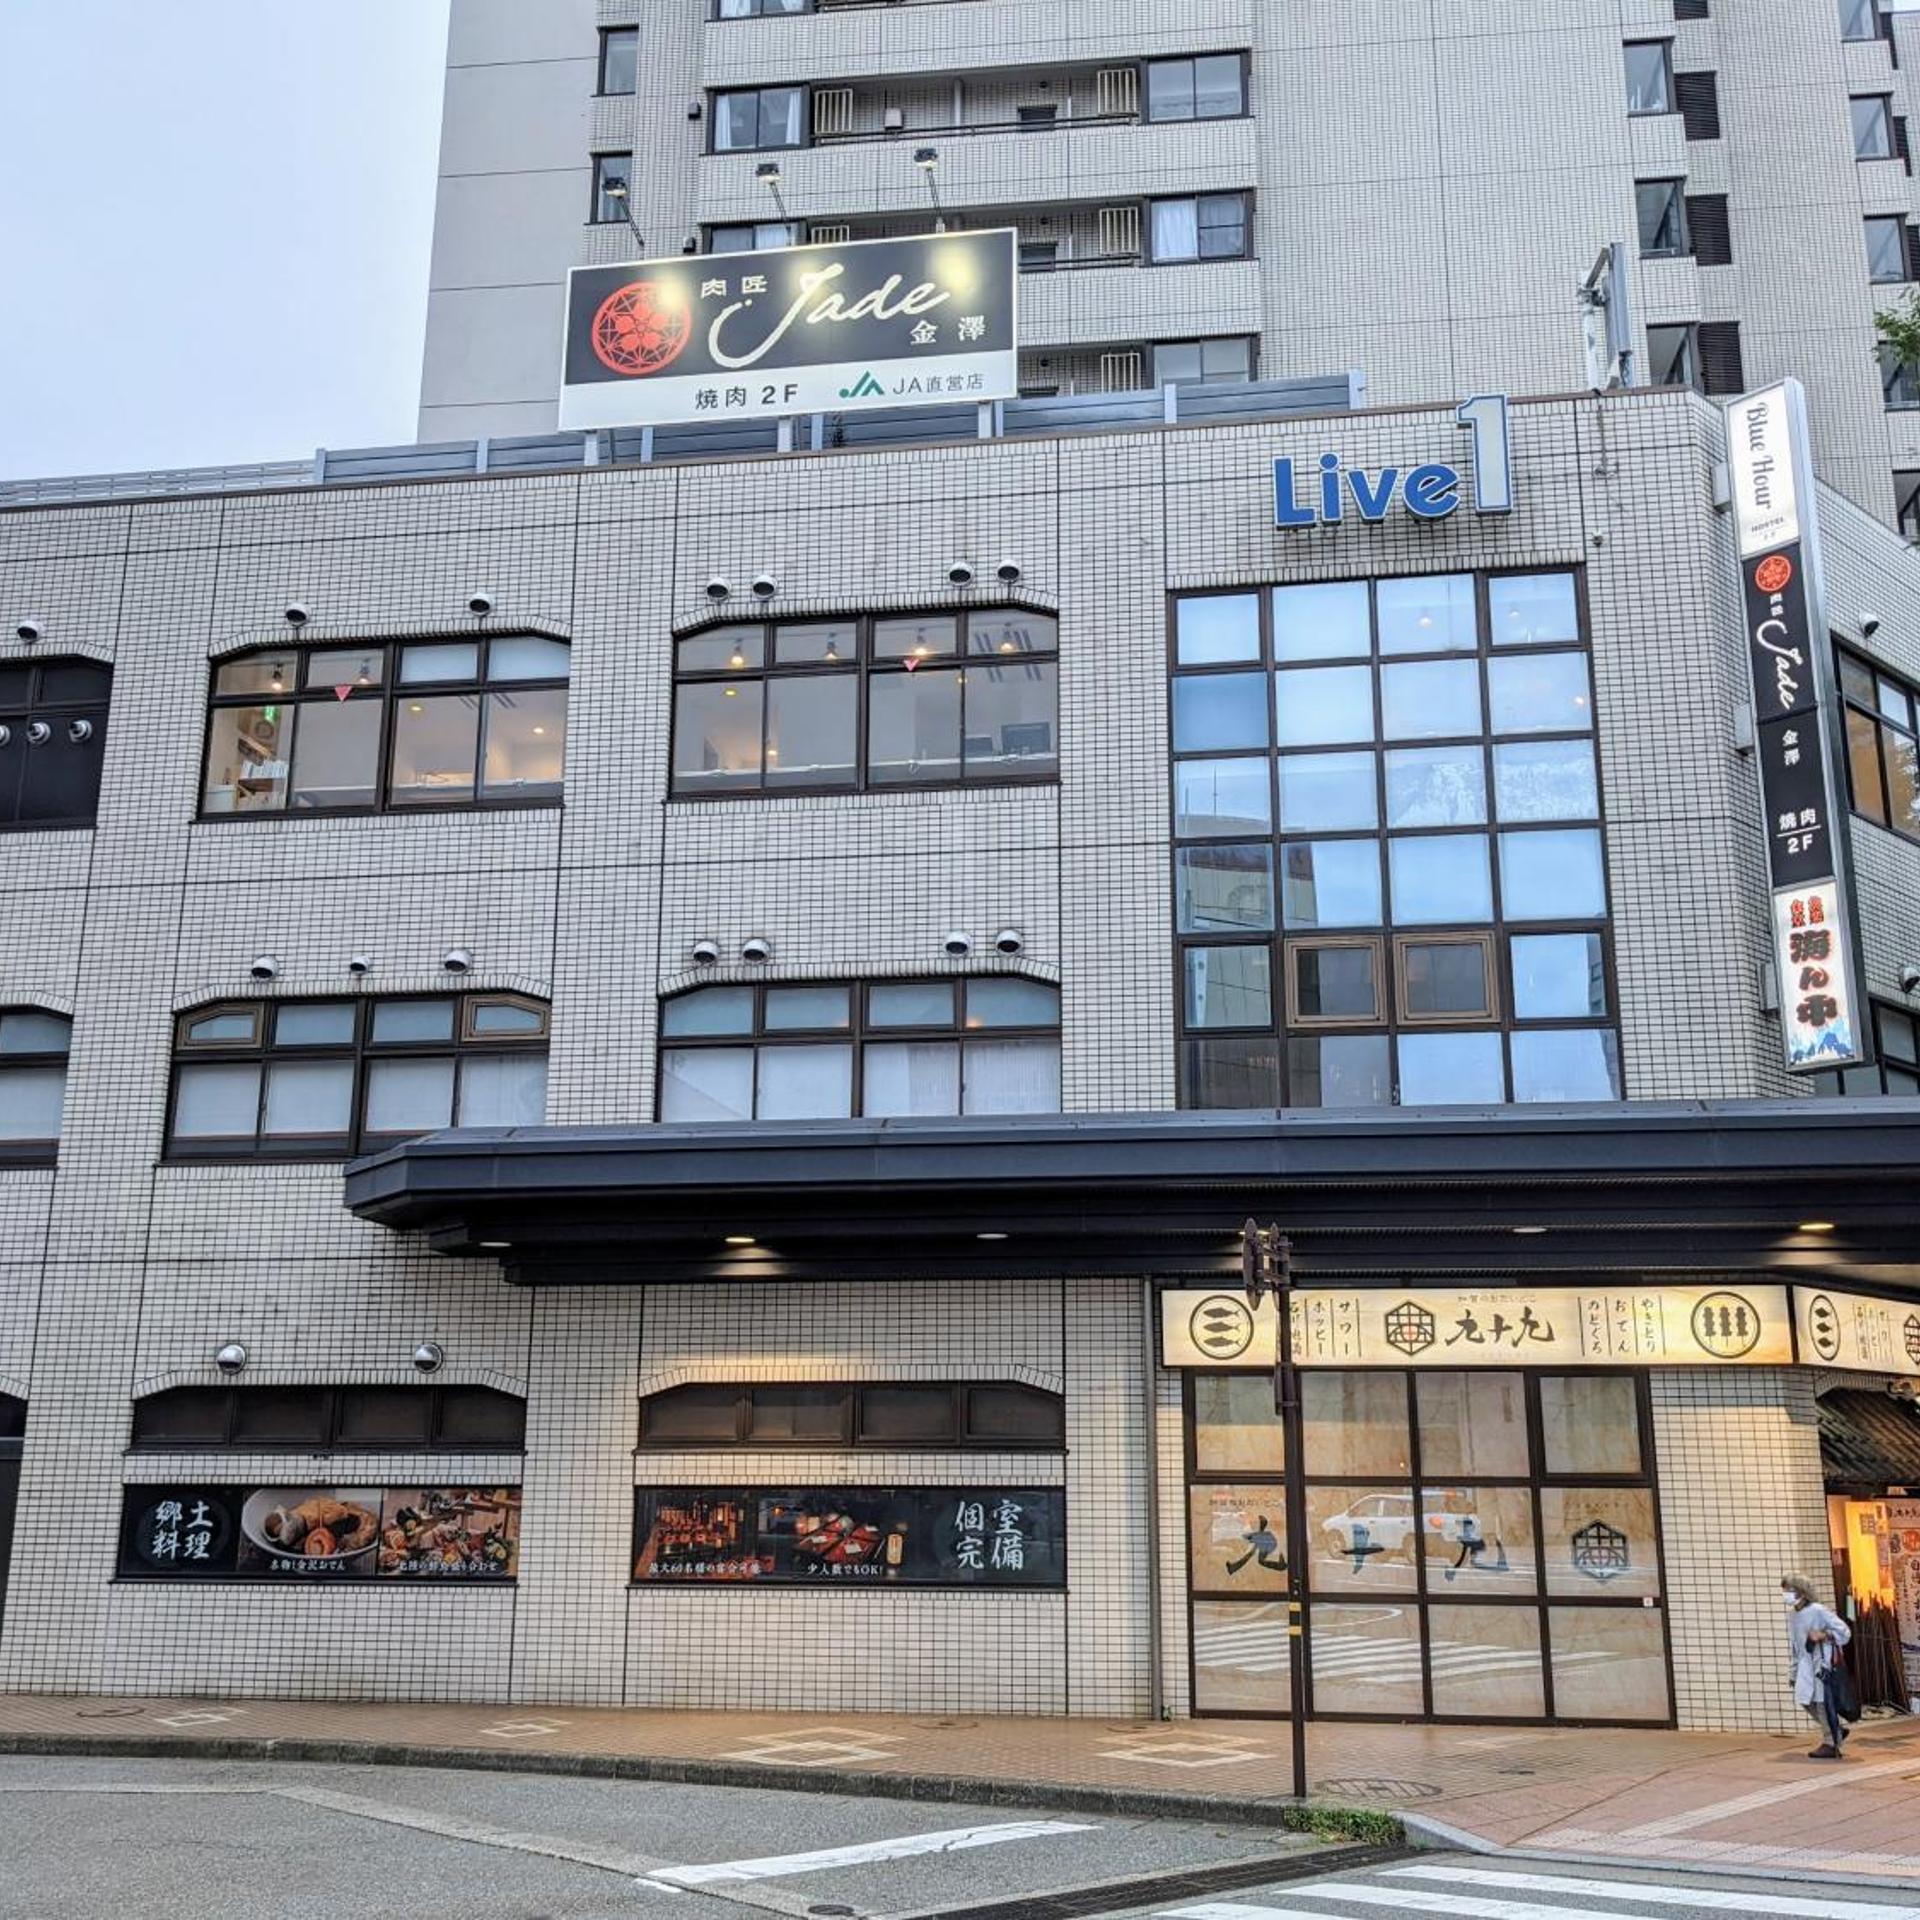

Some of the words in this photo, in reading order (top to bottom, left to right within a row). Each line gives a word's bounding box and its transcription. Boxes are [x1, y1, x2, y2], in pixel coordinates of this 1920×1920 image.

[700, 274, 768, 299] 肉匠
[709, 264, 950, 367] Jade
[694, 386, 747, 411] 焼肉
[761, 384, 799, 405] 2F
[892, 373, 984, 396] JA直営店
[1747, 402, 1769, 452] Blue
[1752, 454, 1776, 511] Hour
[1778, 808, 1817, 831] 焼肉
[1787, 834, 1814, 854] 2F
[1445, 1305, 1556, 1349] 九十九
[1640, 1297, 1657, 1353] やきとり
[154, 1500, 214, 1530] 郷土
[955, 1500, 1023, 1536] 個室
[152, 1530, 211, 1560] 料理
[956, 1535, 1024, 1571] 完備
